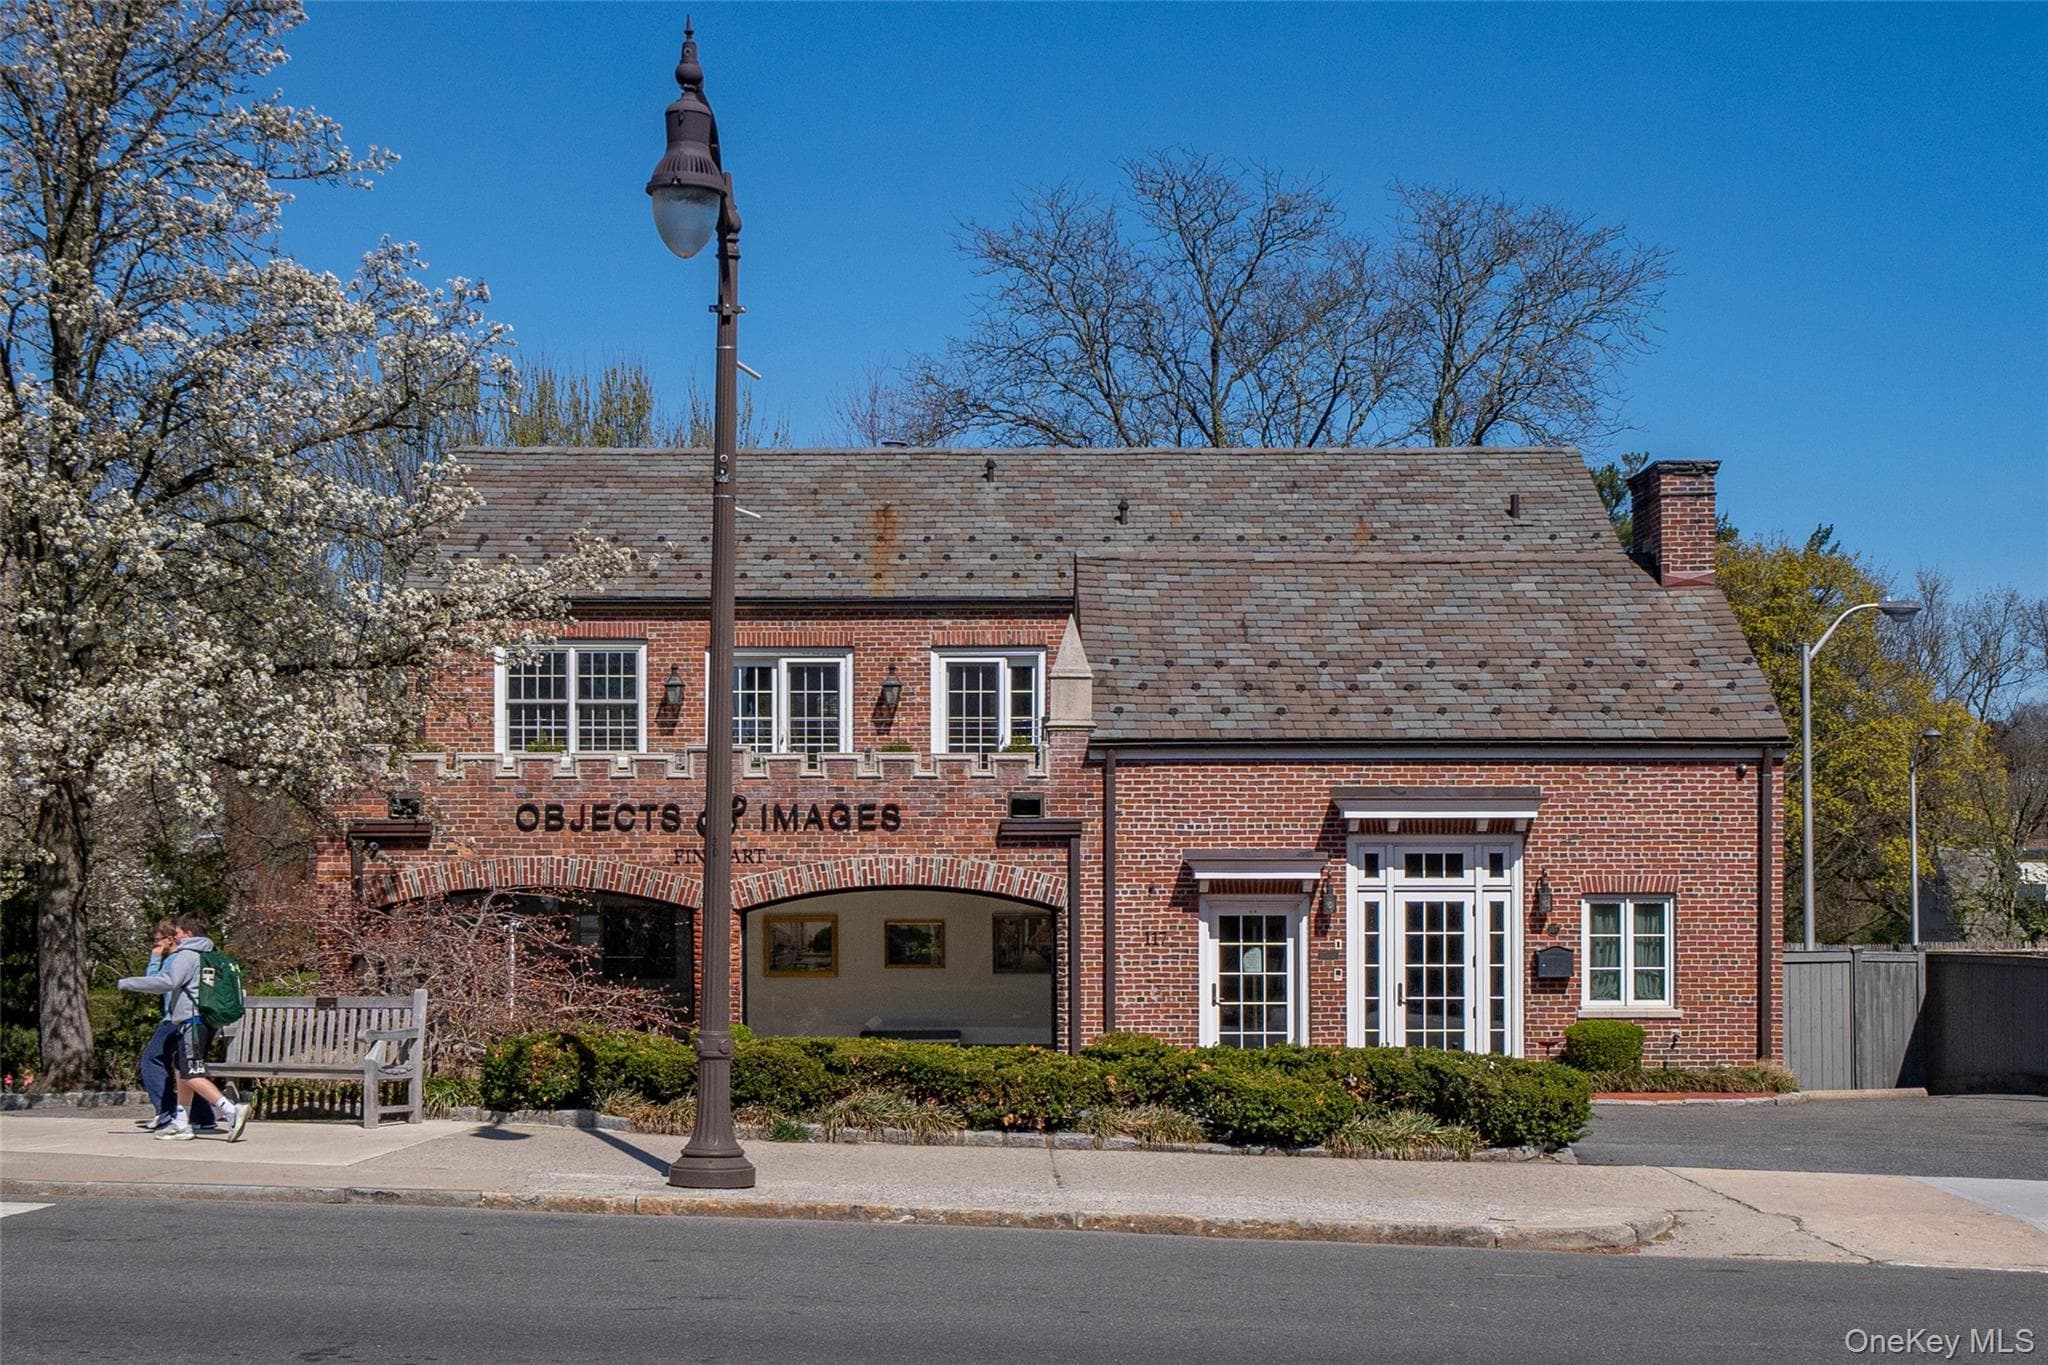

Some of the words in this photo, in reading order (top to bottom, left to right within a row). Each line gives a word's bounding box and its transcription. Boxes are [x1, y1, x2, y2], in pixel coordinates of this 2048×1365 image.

[515, 803, 681, 833] OBJECTS
[761, 803, 901, 833] IMAGES
[673, 848, 706, 865] FIN
[730, 848, 766, 865] ART
[1144, 931, 1168, 947] 117
